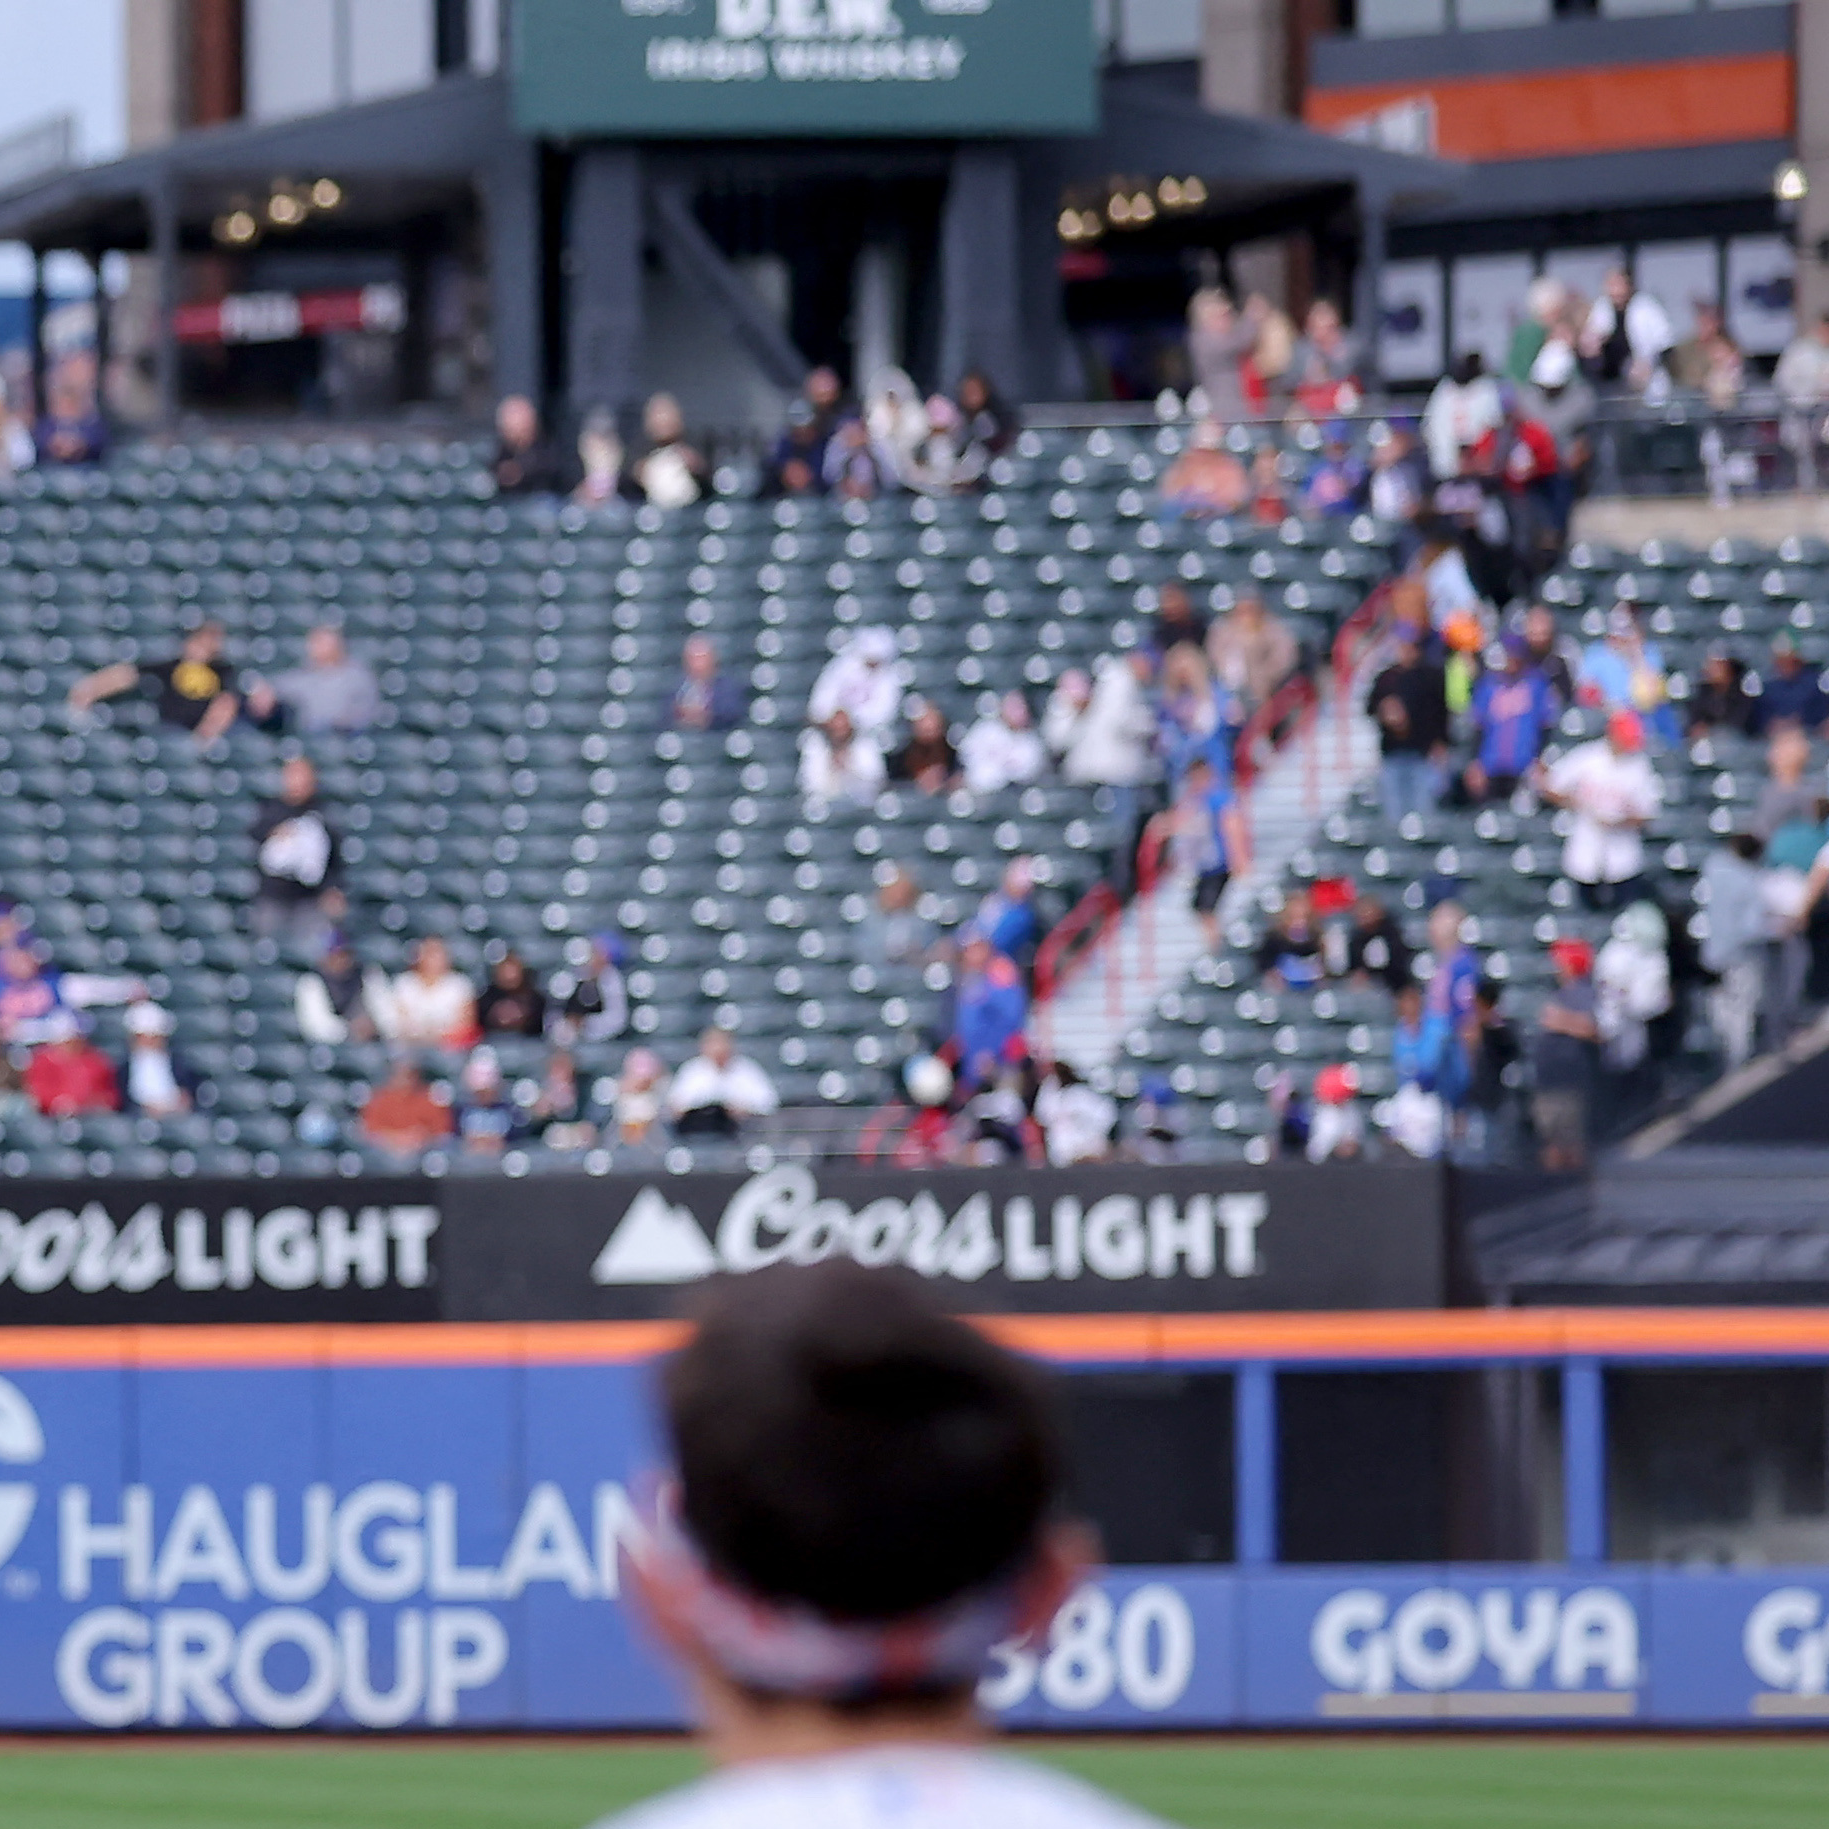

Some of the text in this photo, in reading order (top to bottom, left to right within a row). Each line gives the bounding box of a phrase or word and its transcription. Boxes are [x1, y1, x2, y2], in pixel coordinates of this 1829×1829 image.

[173, 1204, 440, 1291] LIGHT
[714, 1162, 1270, 1282] Coors LIGHT
[58, 1479, 667, 1602] HAUGLAN
[56, 1606, 509, 1729] GROUP
[1309, 1585, 1640, 1698] GOYA
[1745, 1585, 1829, 1698] G
